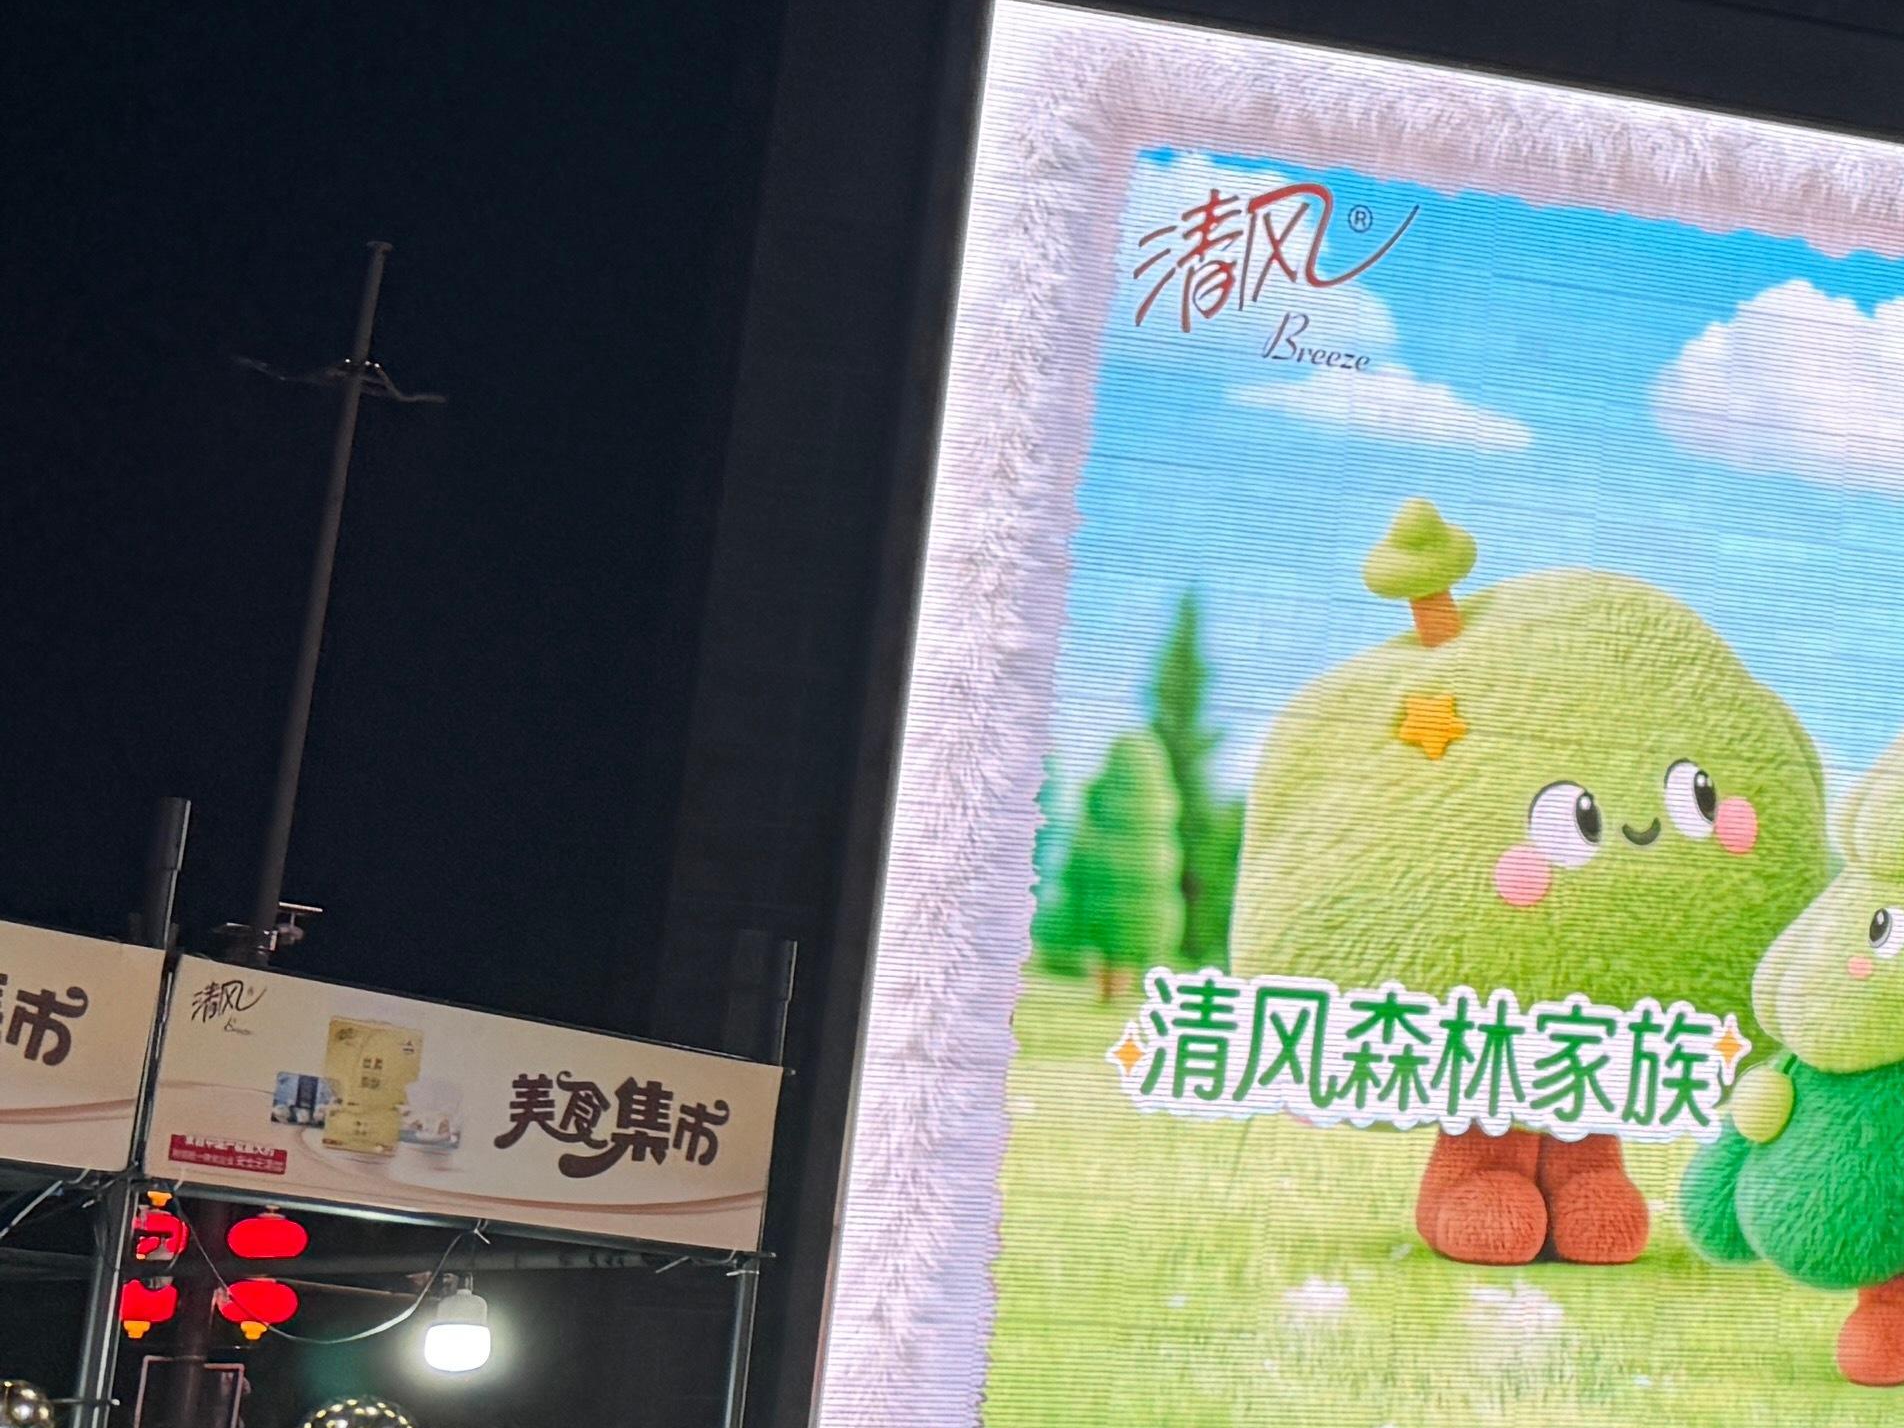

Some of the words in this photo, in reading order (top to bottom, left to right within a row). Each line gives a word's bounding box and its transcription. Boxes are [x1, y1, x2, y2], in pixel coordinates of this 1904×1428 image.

[1133, 183, 1420, 333] 清风
[1262, 311, 1370, 372] Breeze
[0, 972, 89, 1066] 市
[191, 980, 268, 1023] 清风
[1140, 975, 1711, 1127] 清风森林家族
[493, 1070, 730, 1179] 美食集市
